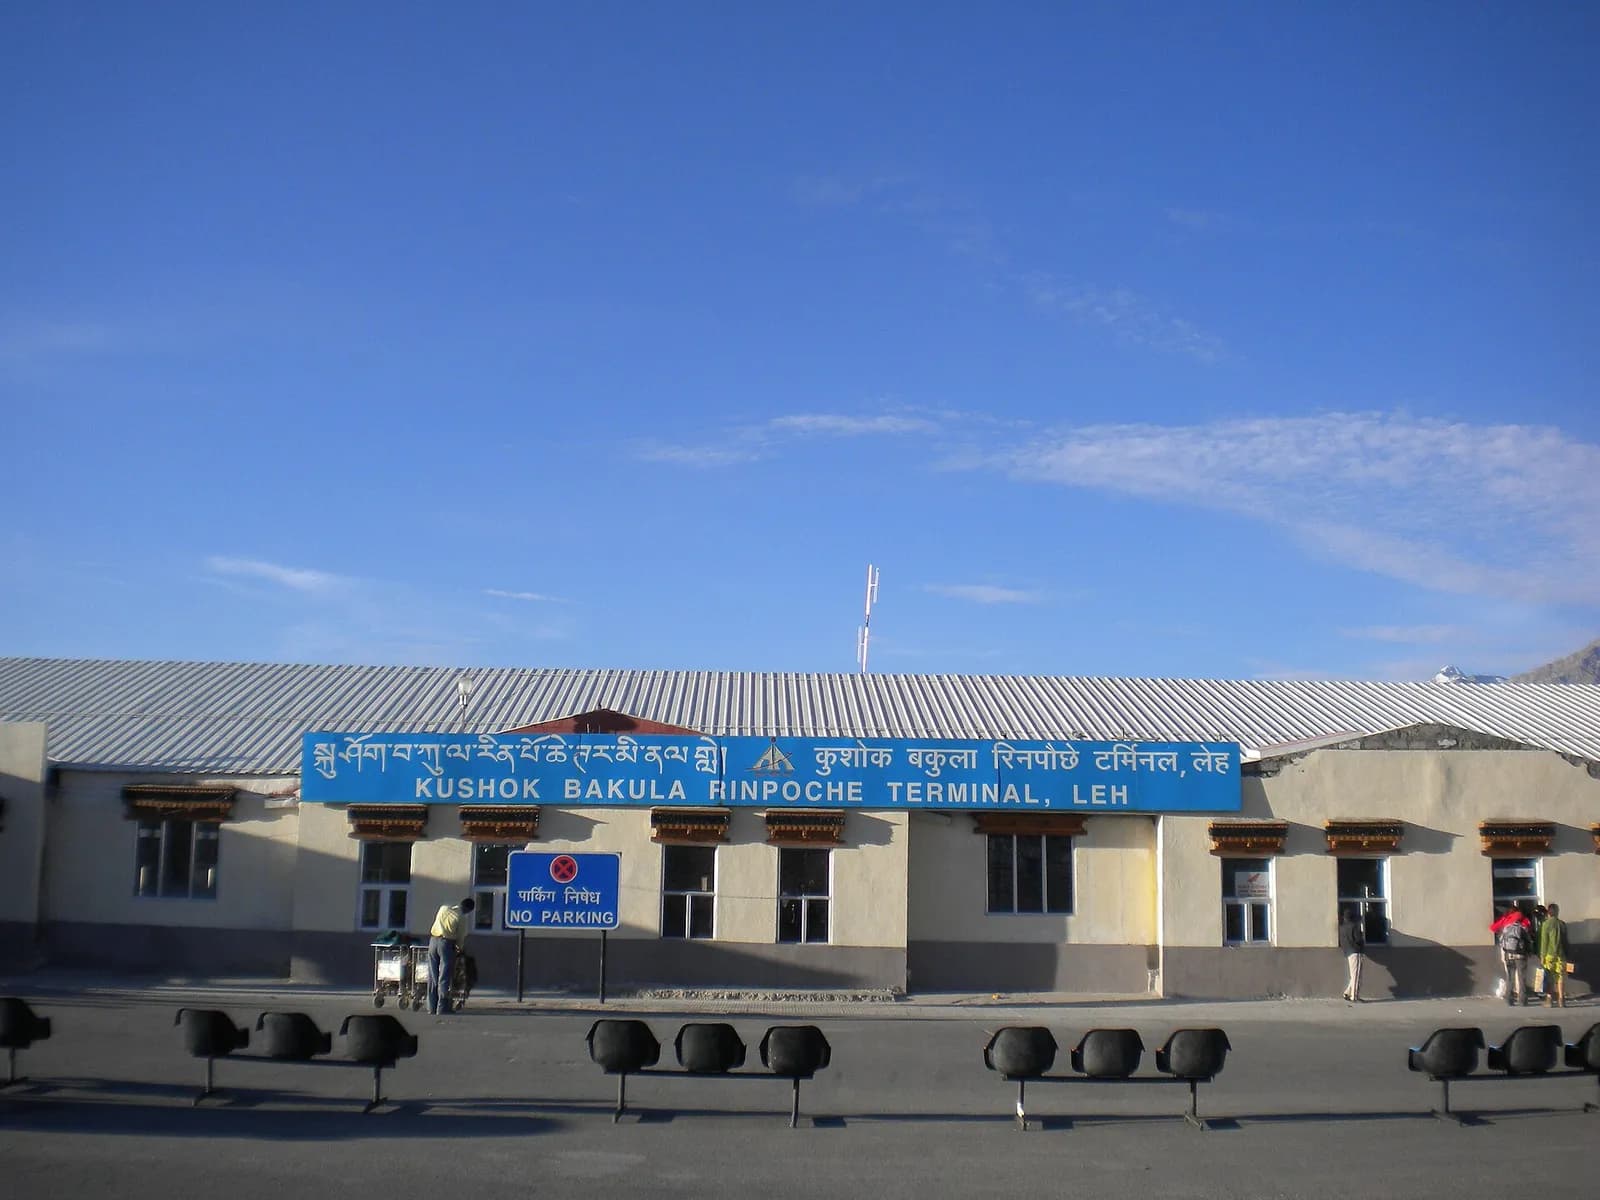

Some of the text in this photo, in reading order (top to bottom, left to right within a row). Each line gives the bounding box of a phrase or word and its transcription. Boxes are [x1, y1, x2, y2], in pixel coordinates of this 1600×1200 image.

[814, 740, 893, 776] कुशोक
[907, 748, 978, 777] बकुला
[991, 742, 1080, 770] रिनपौछे
[1190, 744, 1230, 775] लेह
[415, 778, 1128, 807] KUSHOK BAKULA RINPOCHE TERMINAL, LEH
[564, 886, 601, 905] निषेध
[510, 910, 614, 925] NO PARKING
